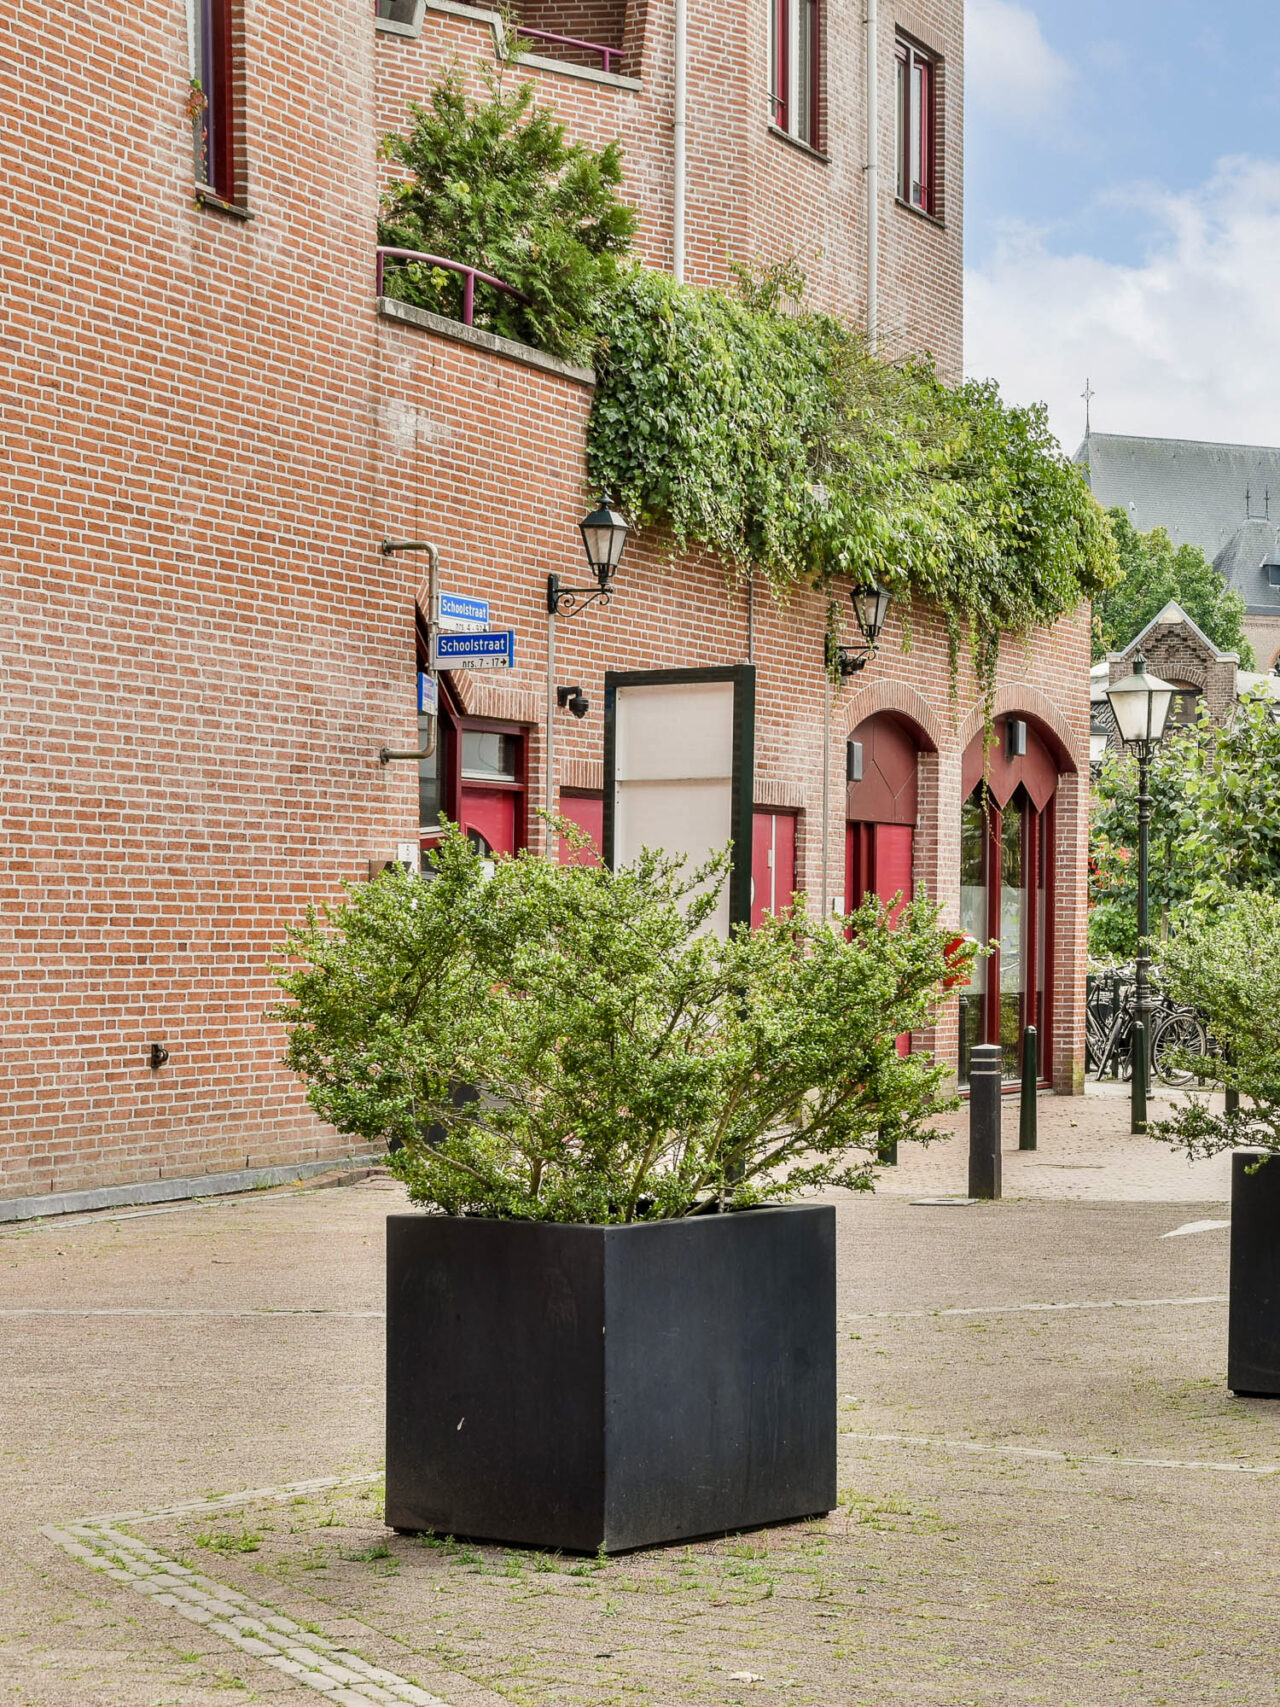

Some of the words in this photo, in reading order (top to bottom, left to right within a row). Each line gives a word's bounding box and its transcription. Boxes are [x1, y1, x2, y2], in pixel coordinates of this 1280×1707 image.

[442, 599, 487, 619] Schoolstraat
[441, 638, 505, 652] Schoolstraat
[462, 660, 477, 668] nrs.
[479, 658, 484, 667] 7
[491, 658, 500, 667] 17
